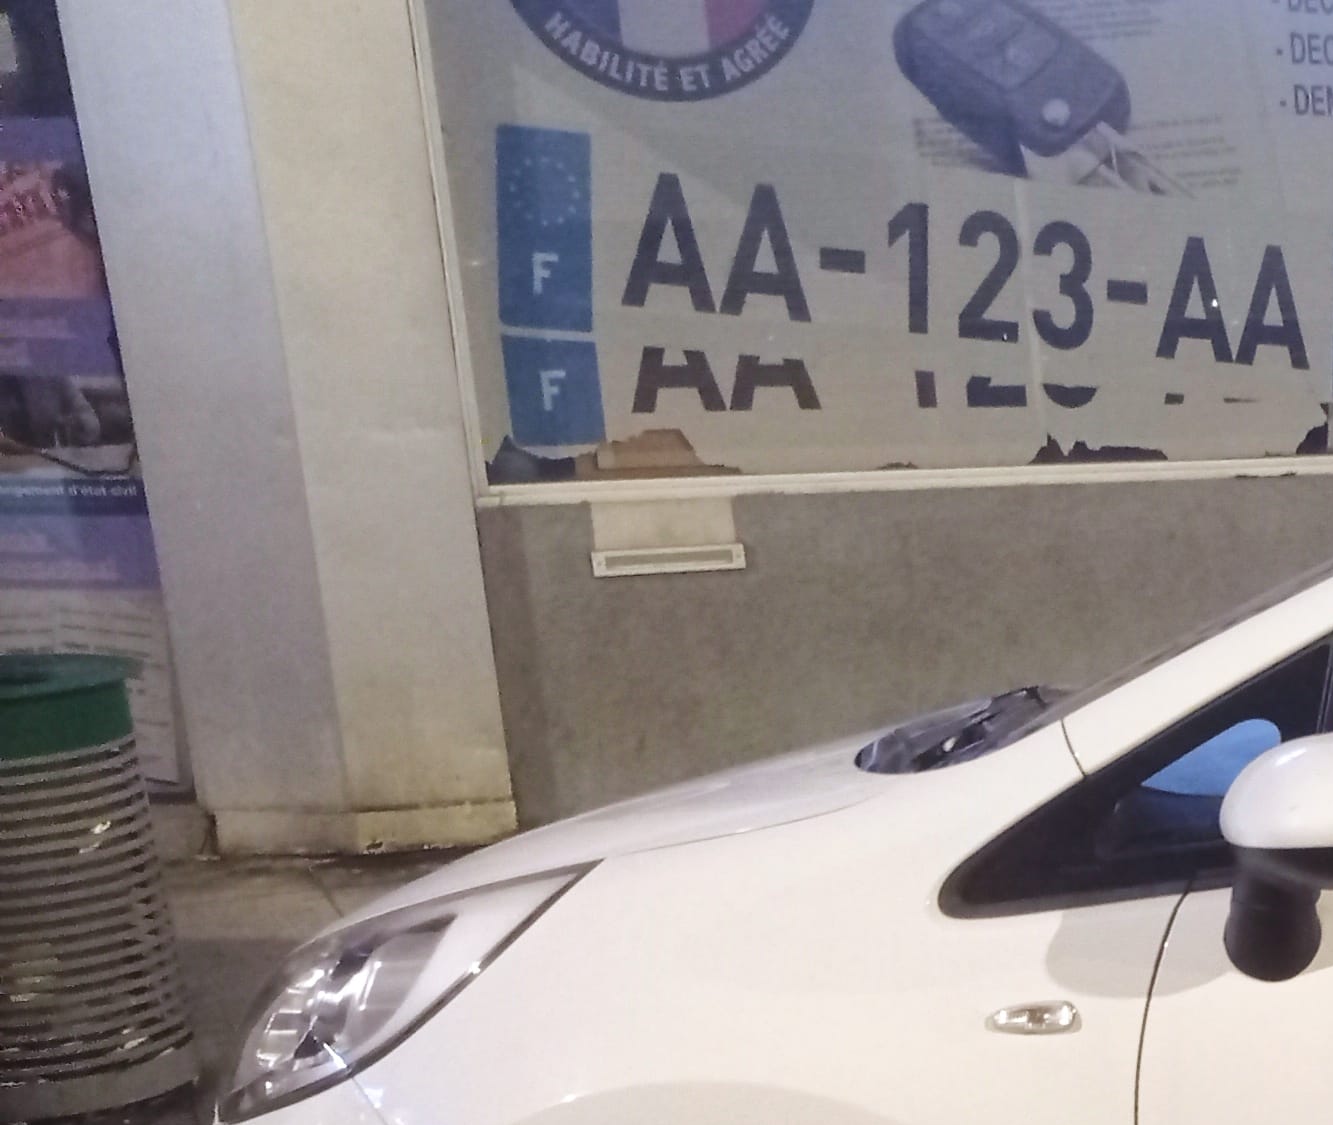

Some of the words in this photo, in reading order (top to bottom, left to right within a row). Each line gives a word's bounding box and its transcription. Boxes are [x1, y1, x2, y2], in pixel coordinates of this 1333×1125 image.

[544, 11, 669, 92] HABILITÉ
[679, 63, 711, 92] ET
[530, 251, 560, 296] F
[620, 172, 1310, 370] AA-123-AA
[538, 368, 567, 412] F
